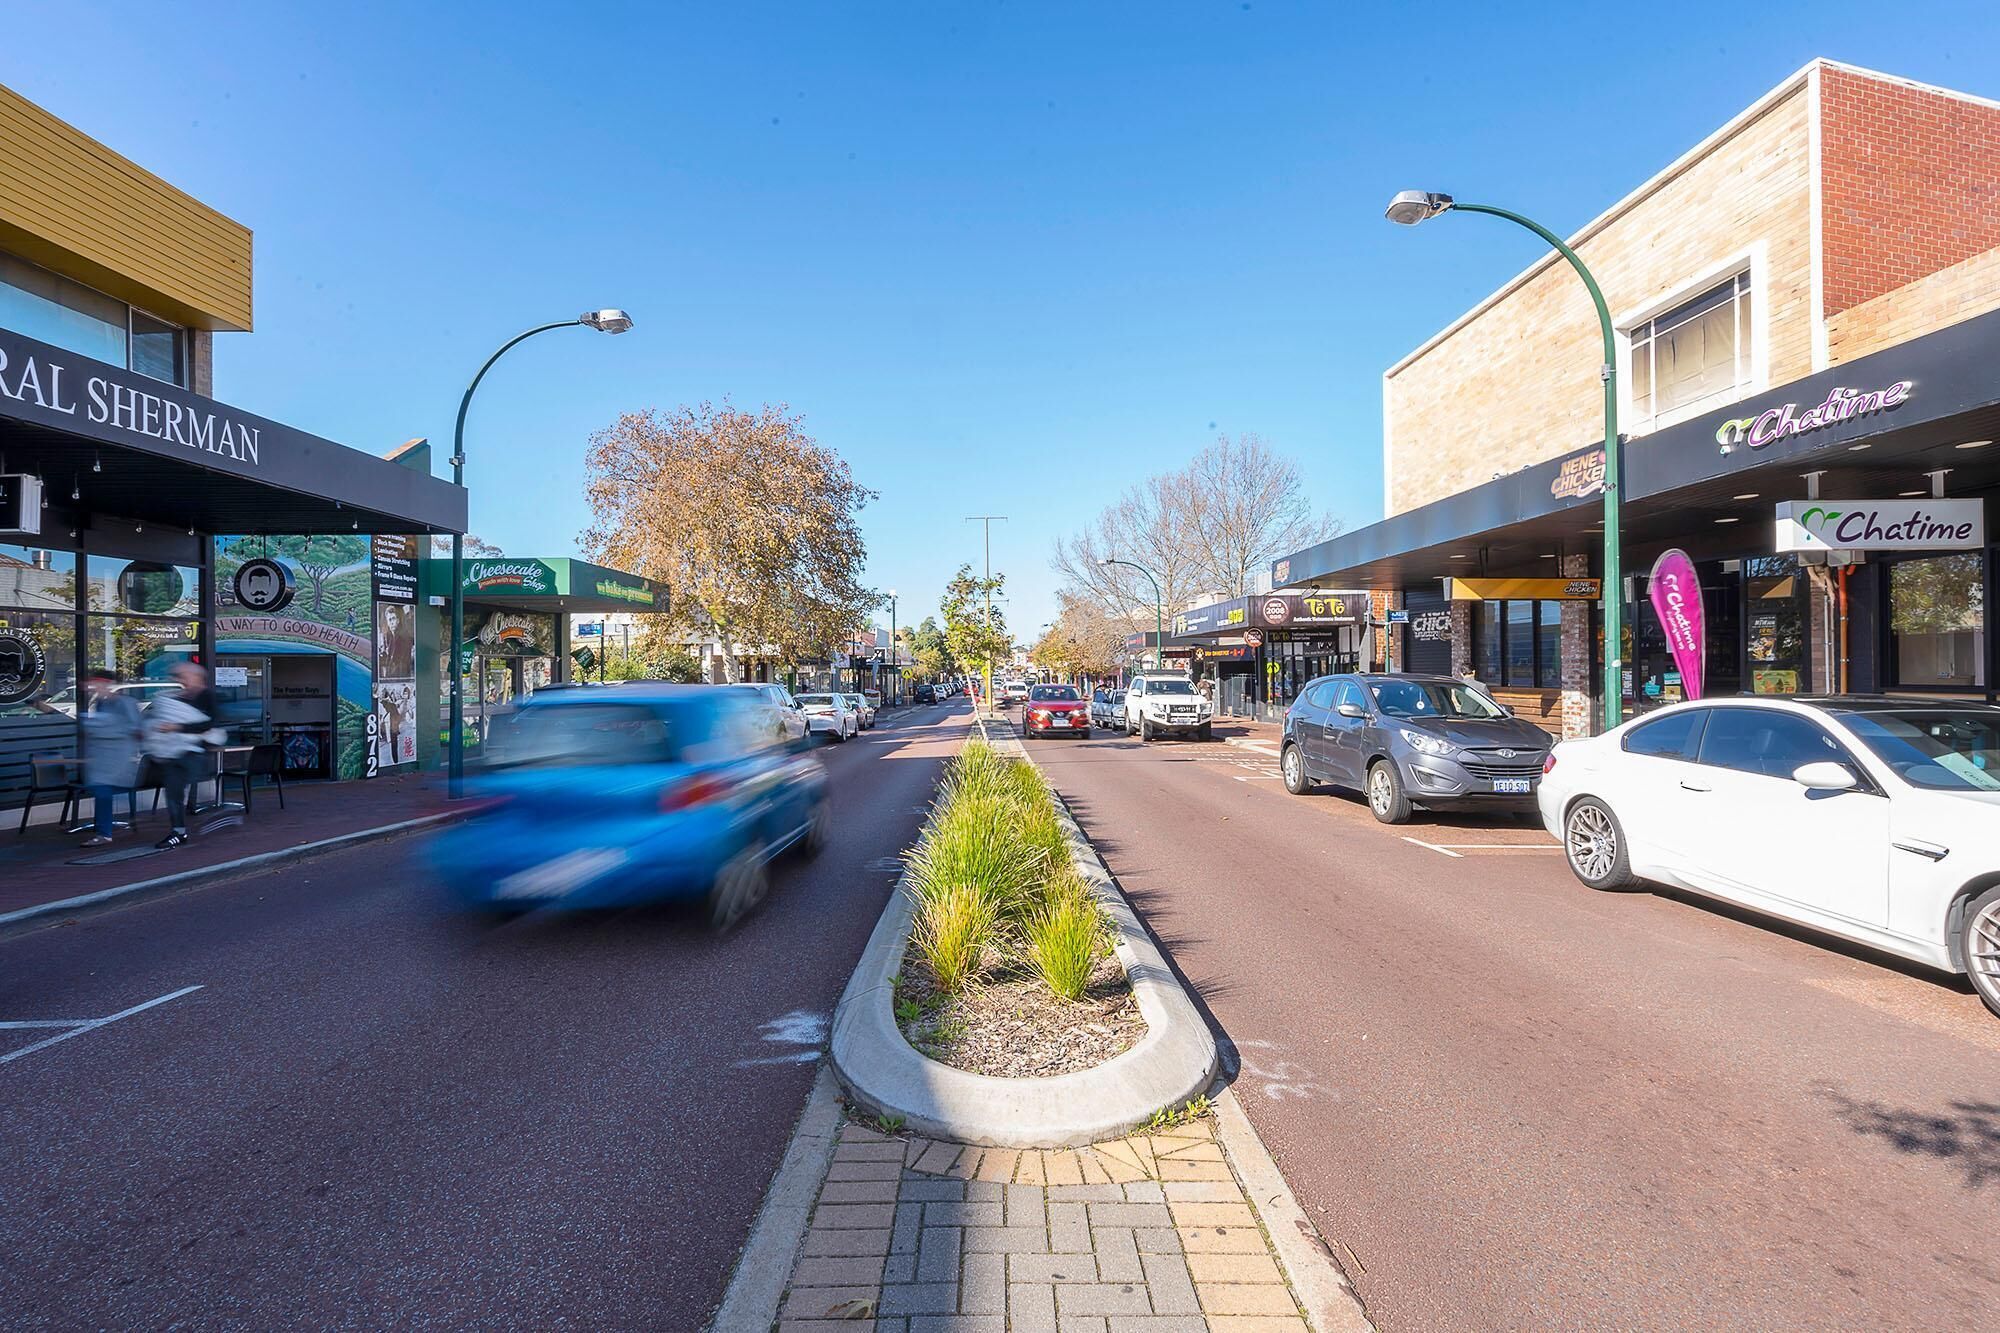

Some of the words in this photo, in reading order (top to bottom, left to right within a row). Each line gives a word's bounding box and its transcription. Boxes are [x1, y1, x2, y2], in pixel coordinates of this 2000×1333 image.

[87, 376, 261, 466] SHERMAN
[1748, 381, 1912, 447] Chatime
[1561, 449, 1600, 476] NENE
[1836, 510, 1973, 543] Chatime
[470, 562, 543, 582] Cheesecake
[523, 576, 546, 591] Shop
[1266, 607, 1285, 615] 2008
[1667, 592, 1697, 651] Chatime
[230, 618, 255, 631] WAY
[261, 618, 278, 631] TO
[283, 620, 317, 635] GOOD
[319, 625, 360, 650] HEALTH
